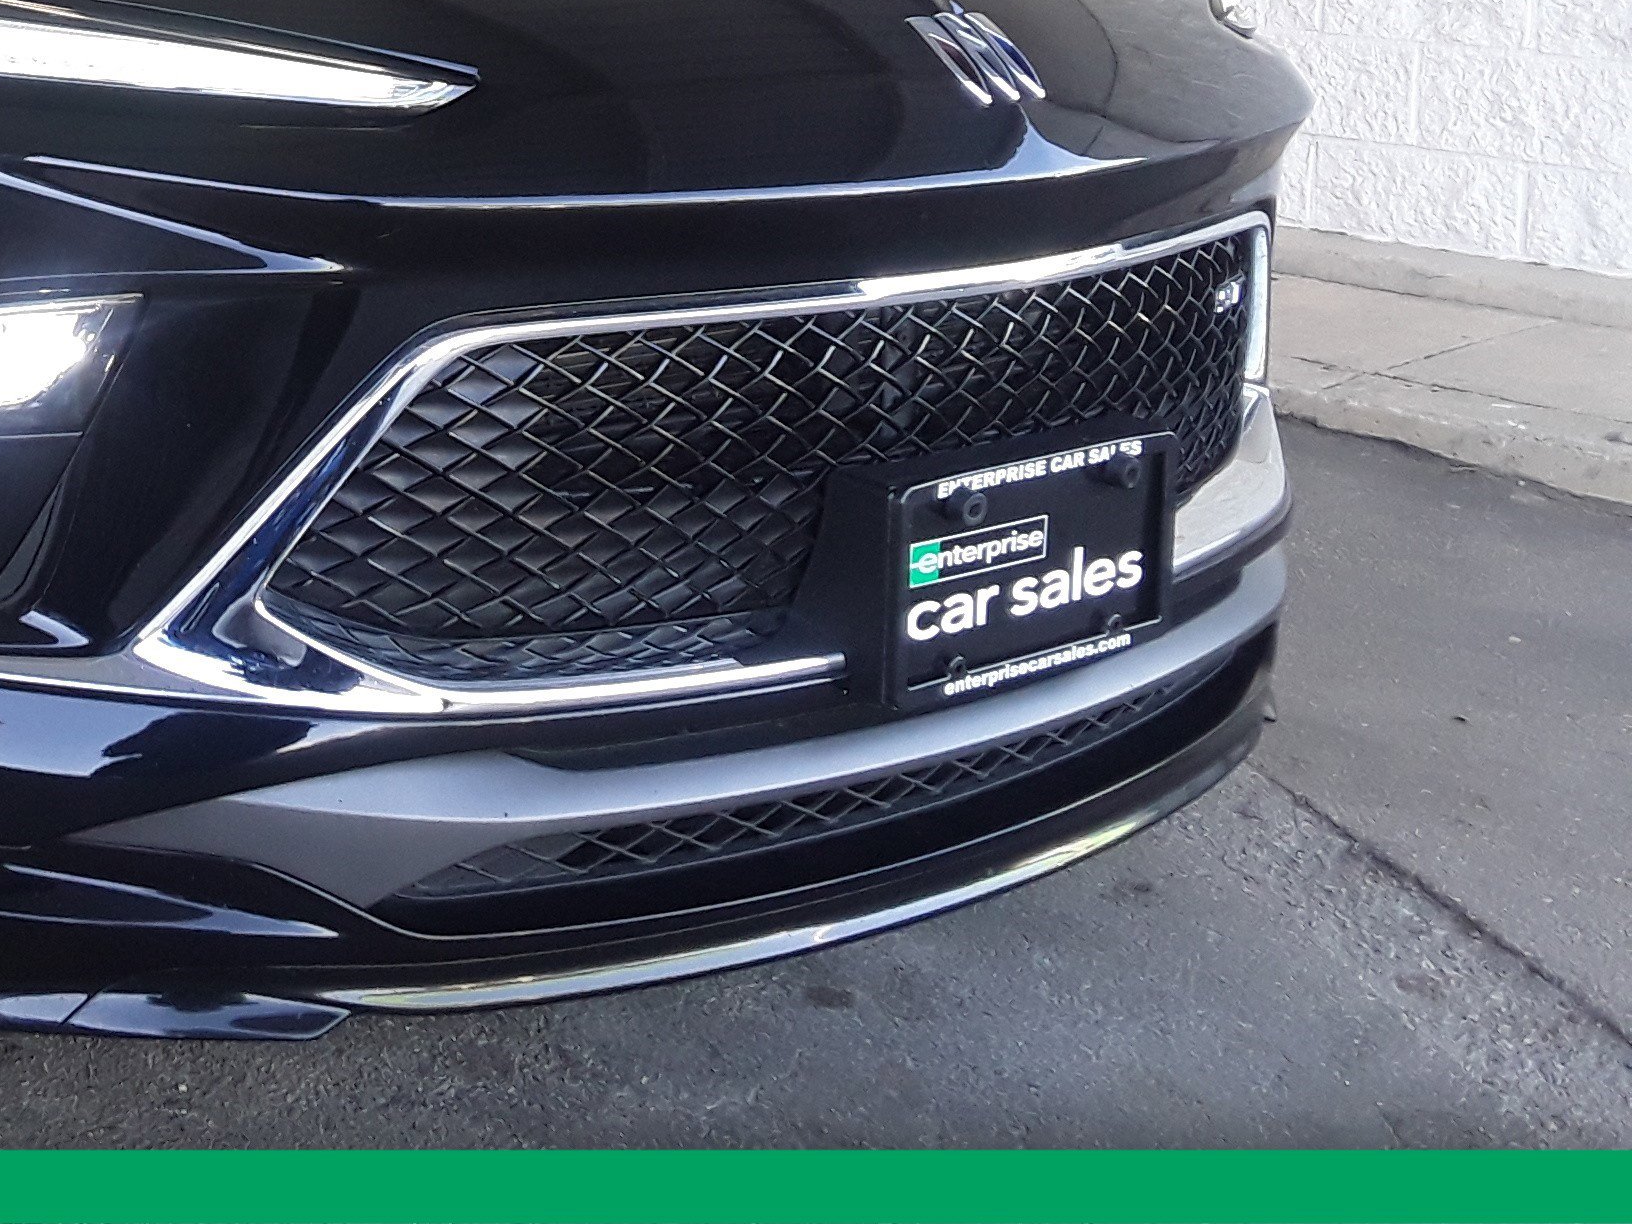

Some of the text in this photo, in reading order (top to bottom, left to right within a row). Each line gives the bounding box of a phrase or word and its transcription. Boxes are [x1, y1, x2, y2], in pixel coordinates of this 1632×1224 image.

[937, 460, 1047, 499] ENTERPRISE
[1050, 451, 1085, 473] CAR
[918, 530, 1044, 574] enterprise
[907, 546, 1143, 641] car sales
[944, 633, 1131, 696] enterprisecarsales.com
